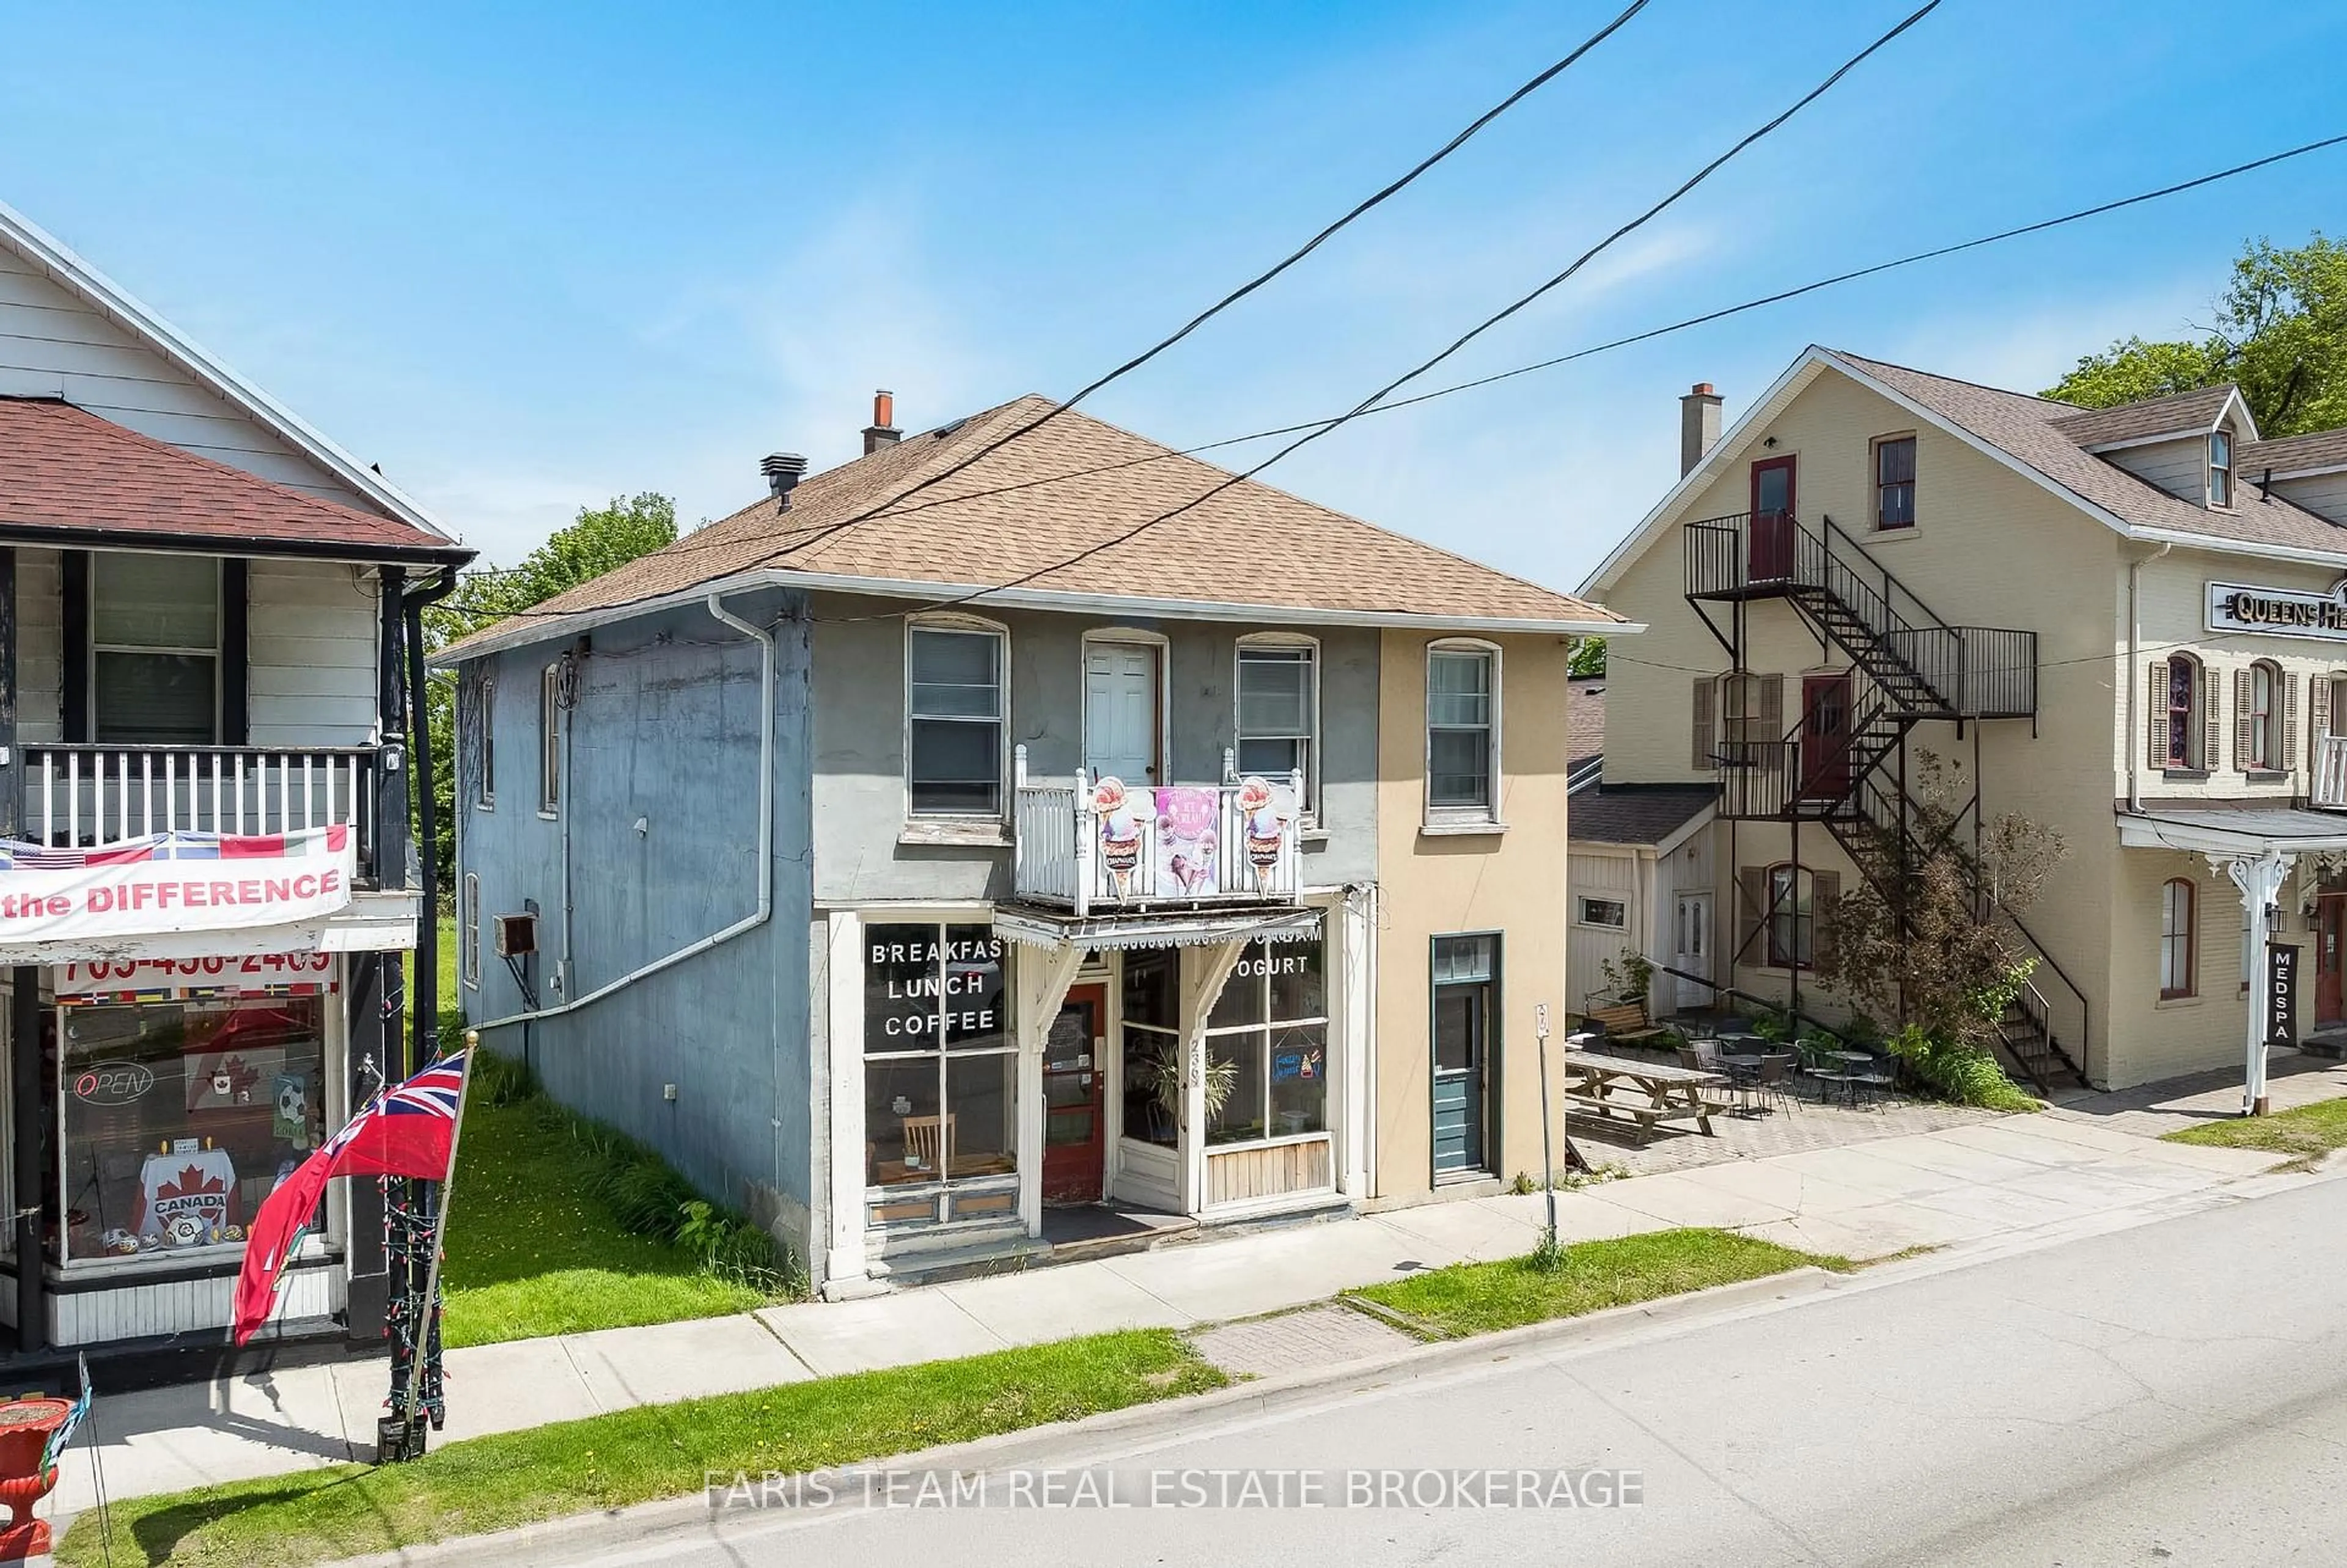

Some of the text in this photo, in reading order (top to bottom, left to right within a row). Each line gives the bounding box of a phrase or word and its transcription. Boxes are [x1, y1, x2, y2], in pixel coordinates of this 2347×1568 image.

[2234, 592, 2319, 627] QUEENS
[1, 868, 339, 918] the DIFFERENCE
[1238, 956, 1308, 977] OGURT
[888, 975, 983, 999] LUNCH
[2275, 953, 2290, 1039] MEDSPA
[885, 1009, 994, 1036] COFFEE
[77, 1072, 146, 1096] OPEN
[155, 1196, 225, 1214] CANADA
